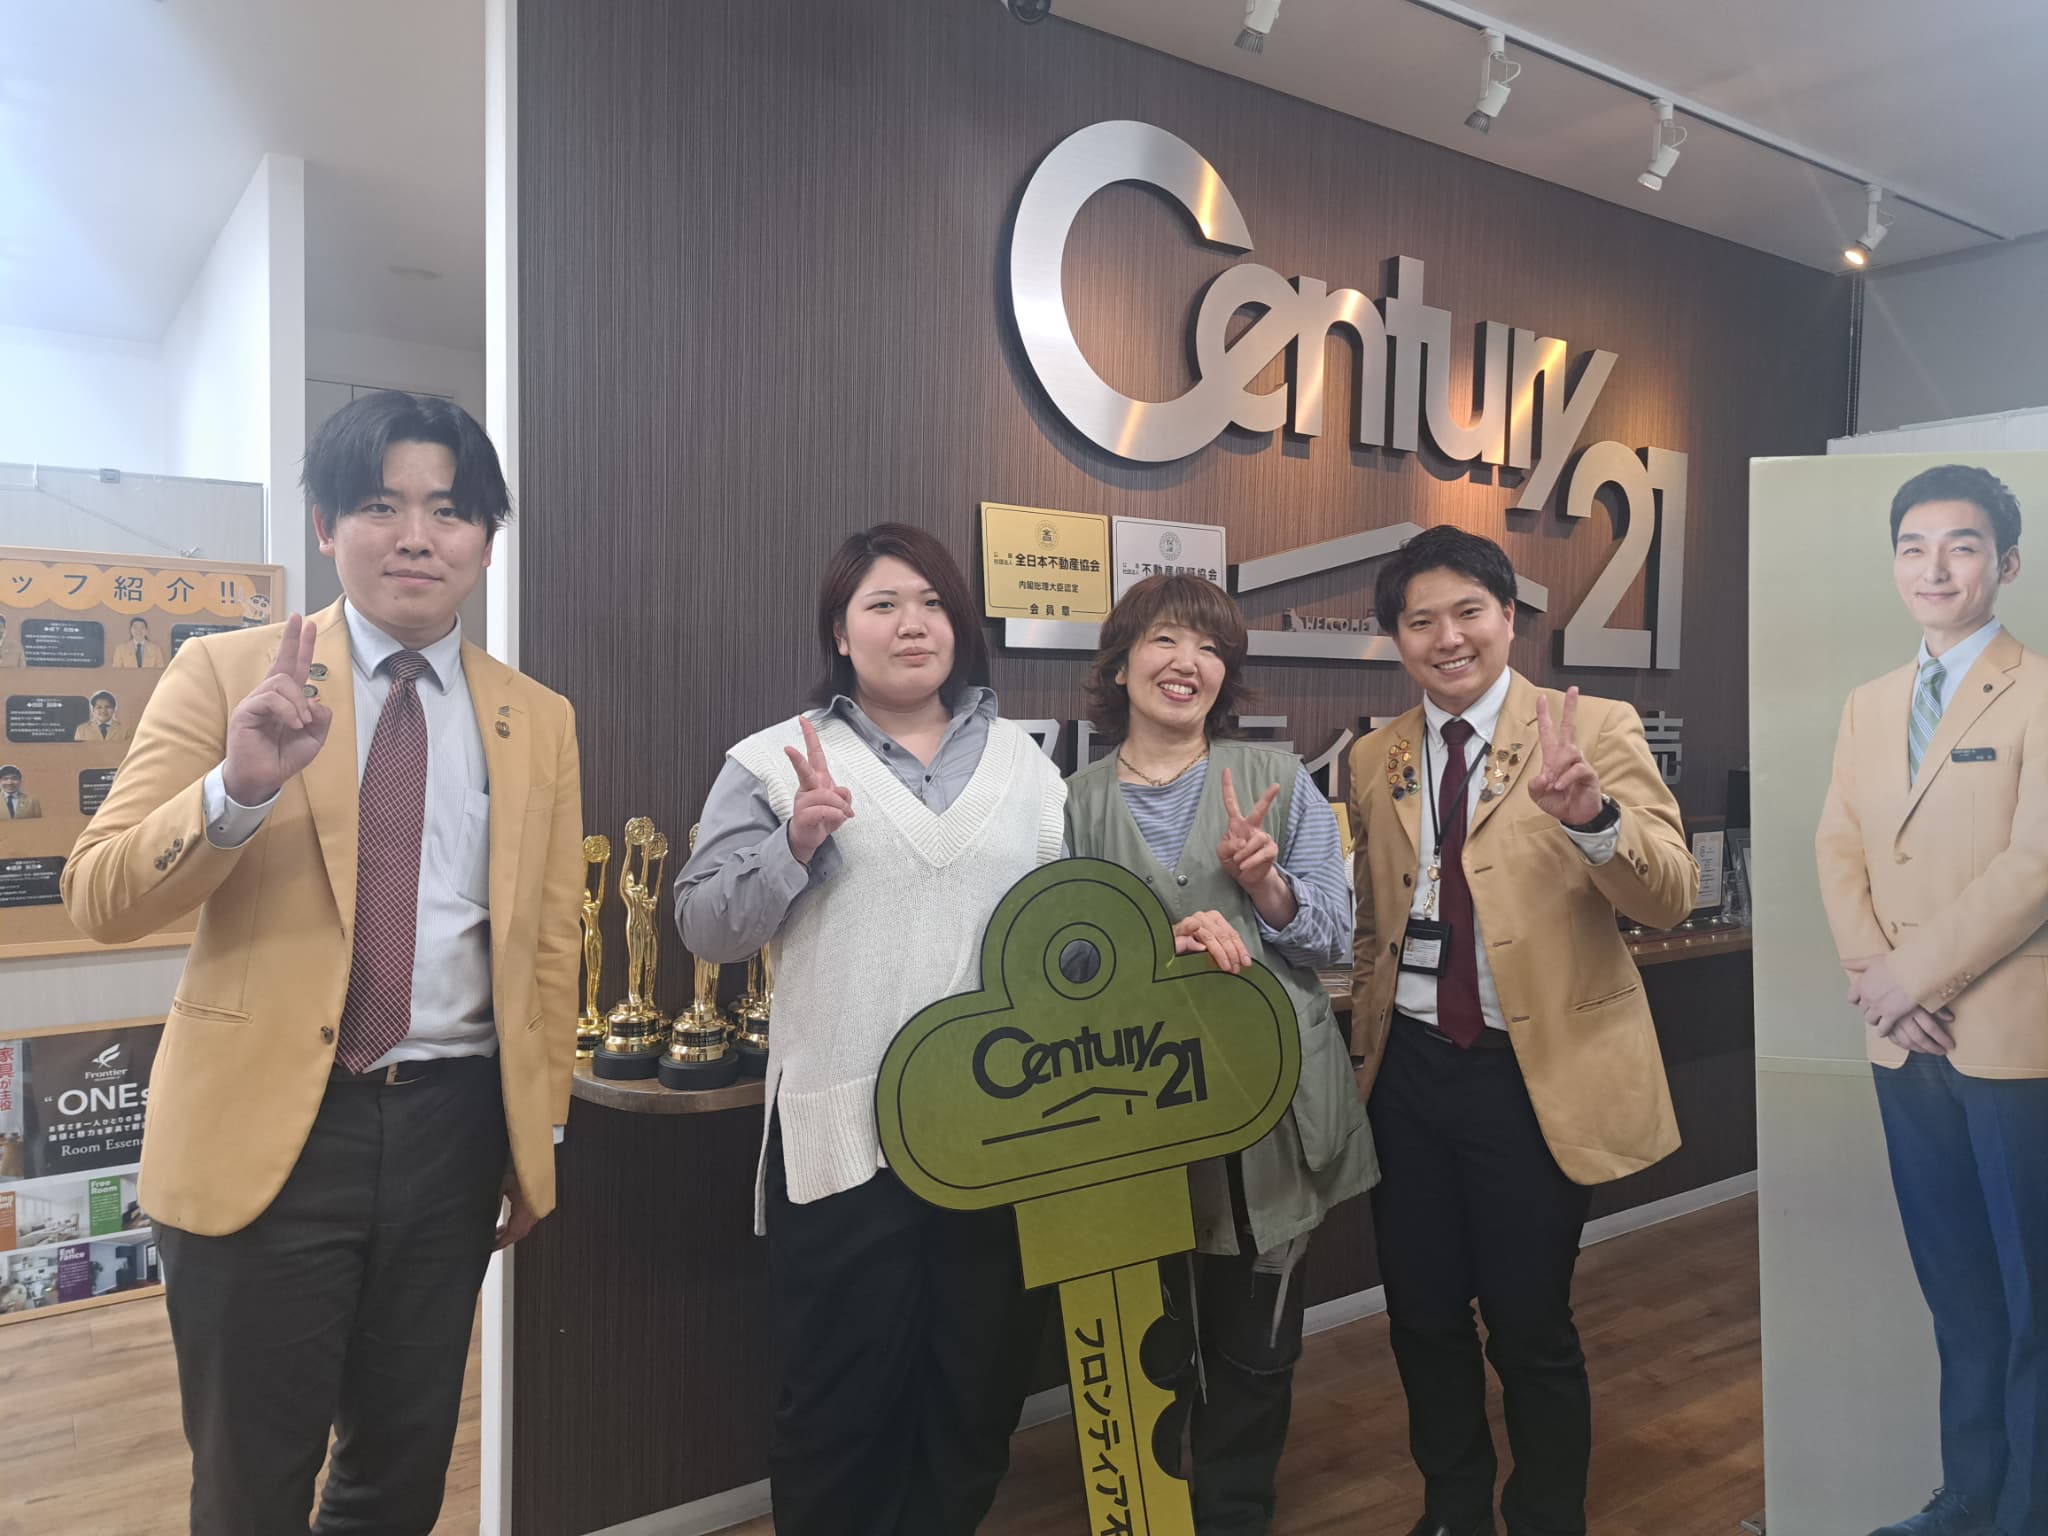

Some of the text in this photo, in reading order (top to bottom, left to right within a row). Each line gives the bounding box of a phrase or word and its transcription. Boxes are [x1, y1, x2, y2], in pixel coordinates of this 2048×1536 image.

[1010, 120, 1619, 510] Century
[1015, 553, 1101, 573] 全日本不動産協会
[1562, 440, 1688, 669] 21
[84, 1068, 128, 1080] Frontier
[972, 1021, 1165, 1099] Century
[1149, 1038, 1208, 1109] 21
[61, 1144, 100, 1157] Room
